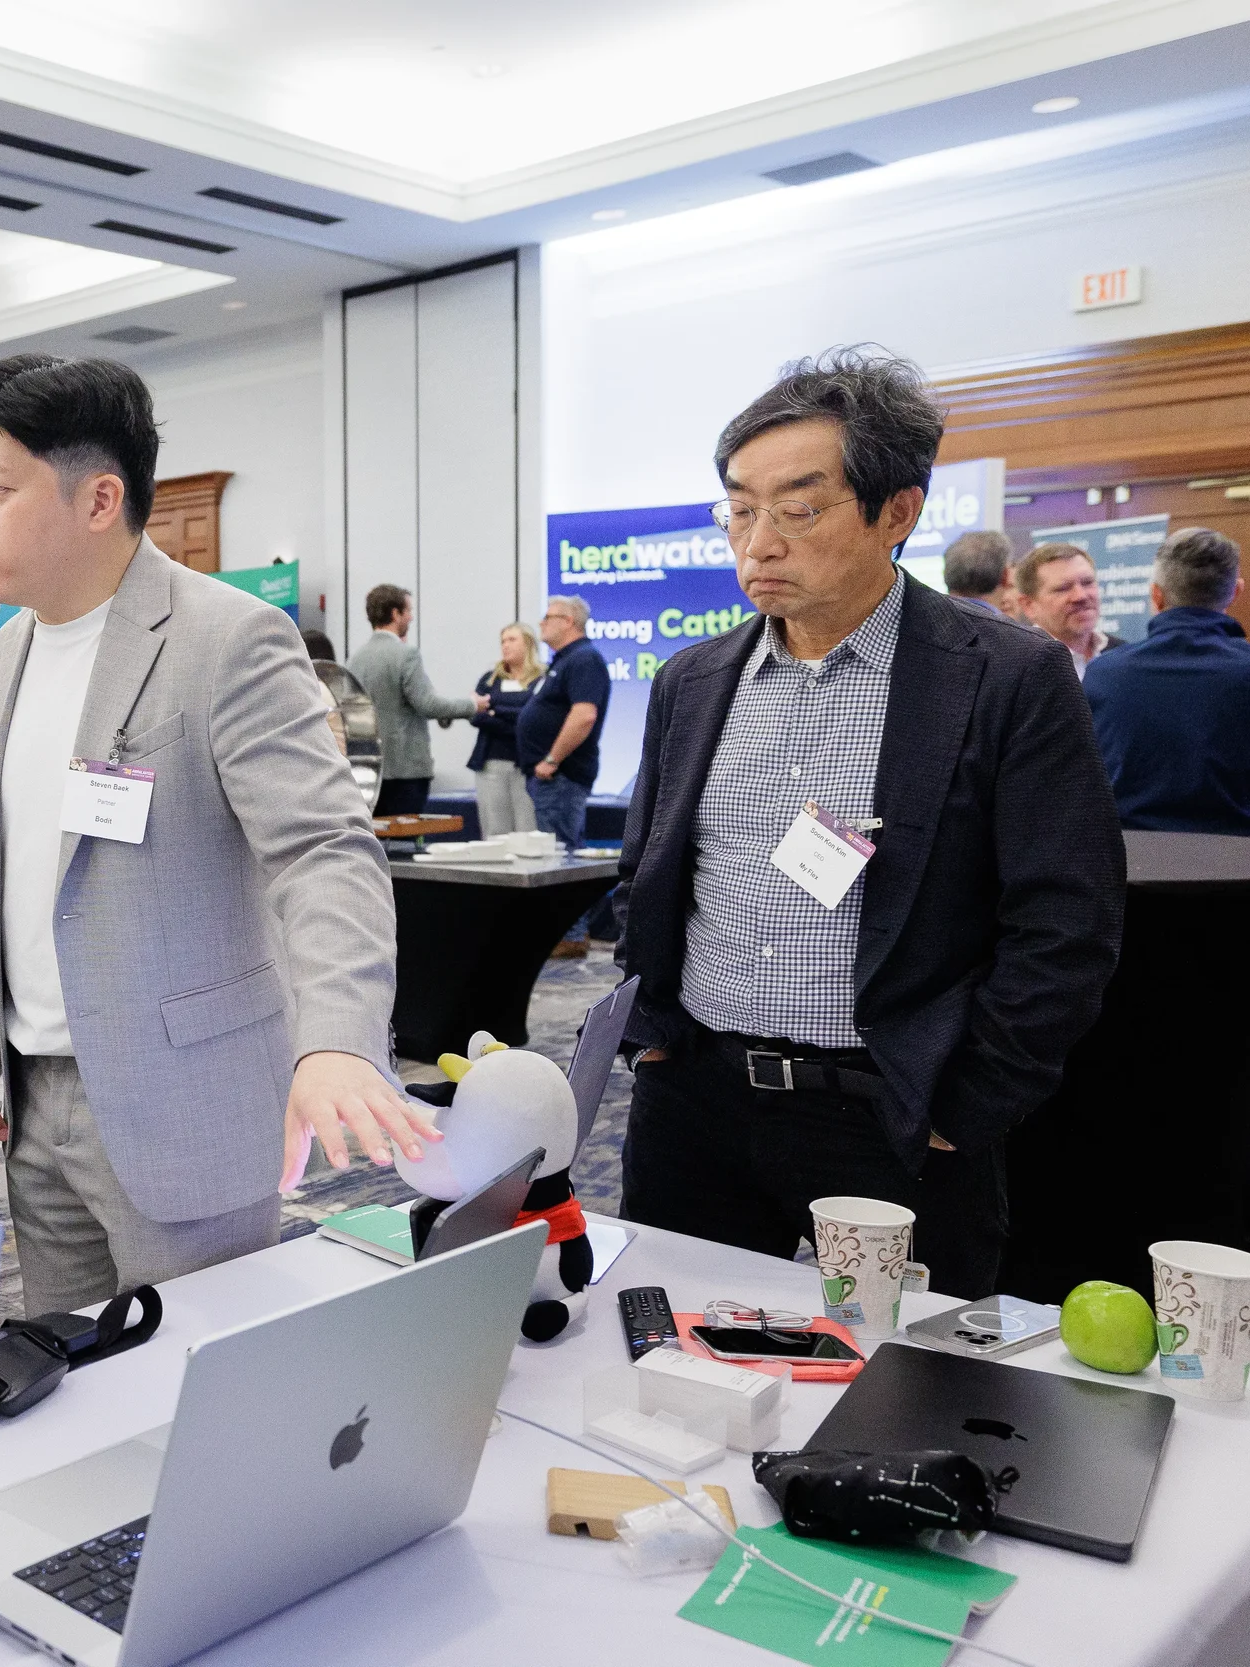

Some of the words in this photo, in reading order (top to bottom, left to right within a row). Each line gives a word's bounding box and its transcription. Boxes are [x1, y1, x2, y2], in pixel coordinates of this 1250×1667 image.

[1083, 268, 1127, 304] EXIT
[586, 618, 653, 645] trong
[90, 779, 112, 789] Steven
[113, 783, 130, 792] Baek
[97, 798, 116, 807] Partner
[95, 815, 113, 825] Bodit
[810, 827, 825, 842] Soon
[824, 837, 837, 850] Kon
[836, 846, 848, 858] Kim
[813, 851, 825, 862] CEO
[799, 862, 808, 873] My
[807, 869, 819, 881] Flex
